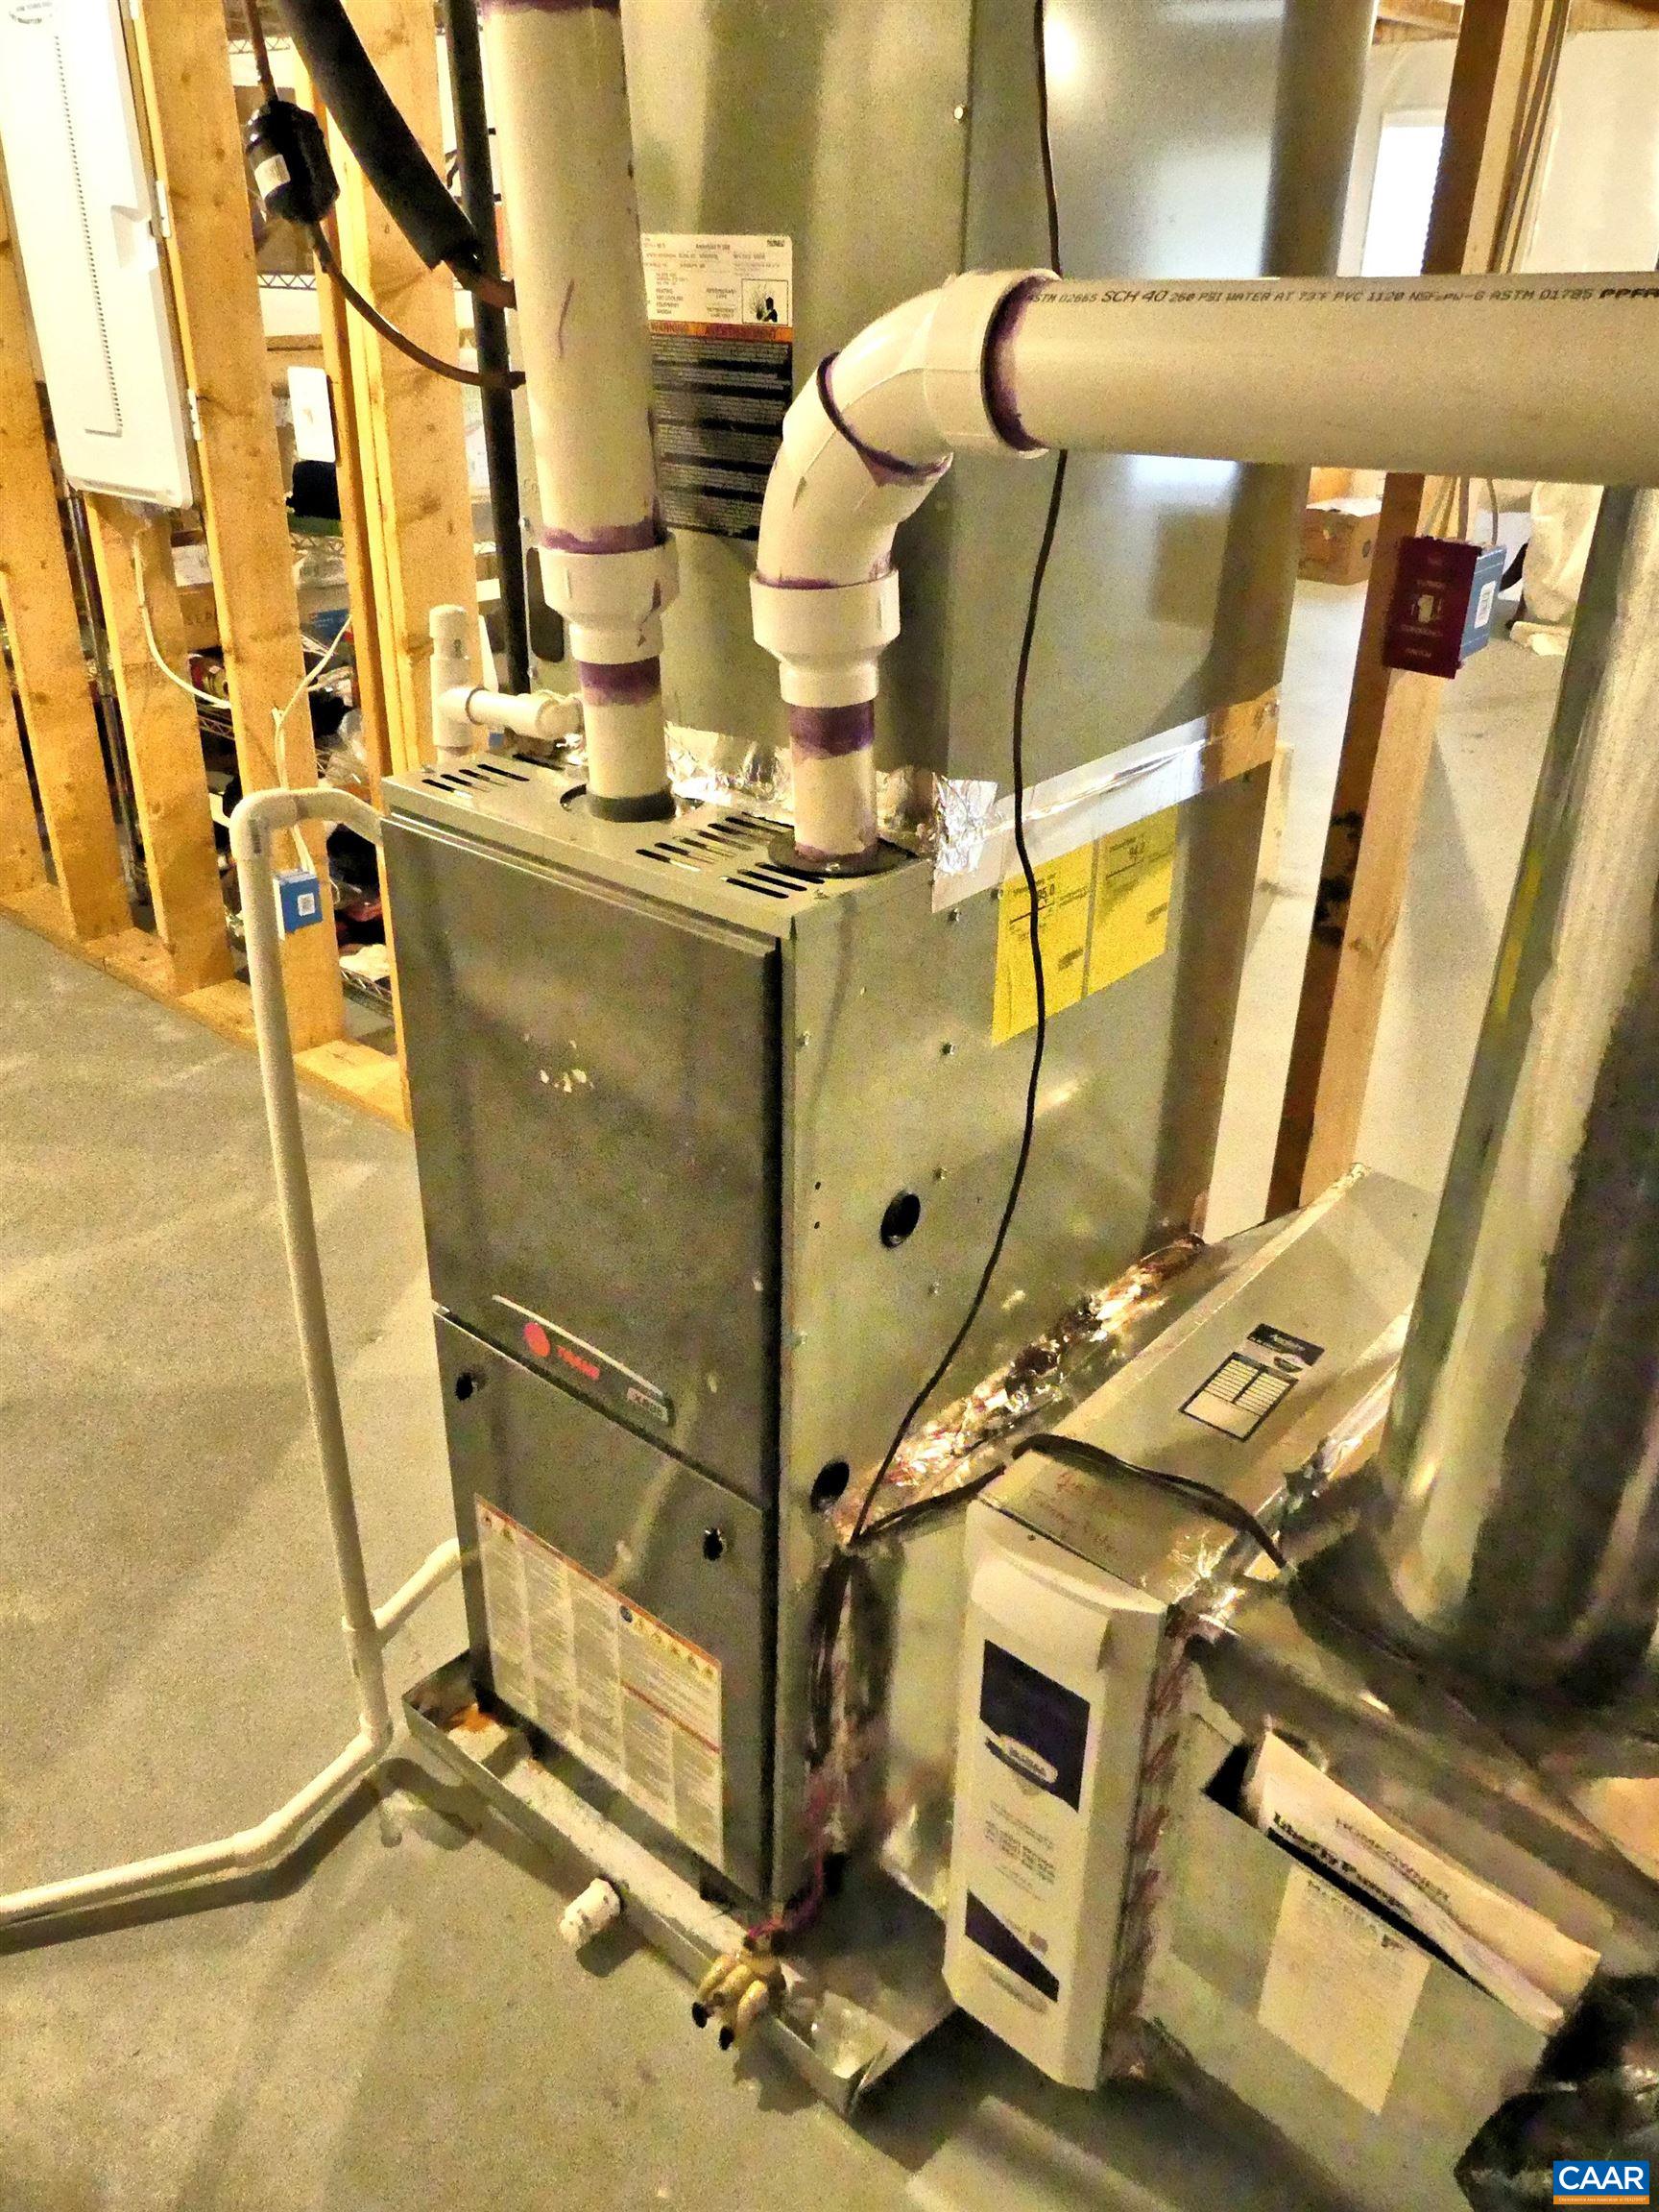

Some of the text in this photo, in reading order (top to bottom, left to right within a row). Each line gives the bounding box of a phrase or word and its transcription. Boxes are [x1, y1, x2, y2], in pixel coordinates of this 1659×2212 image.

[1101, 291, 1141, 302] SCH
[1142, 290, 1168, 302] 40
[1197, 292, 1224, 302] PSI
[1225, 292, 1272, 302] WATER
[1273, 292, 1294, 302] AT
[1333, 291, 1363, 302] PVC
[1488, 290, 1535, 301] ASTM
